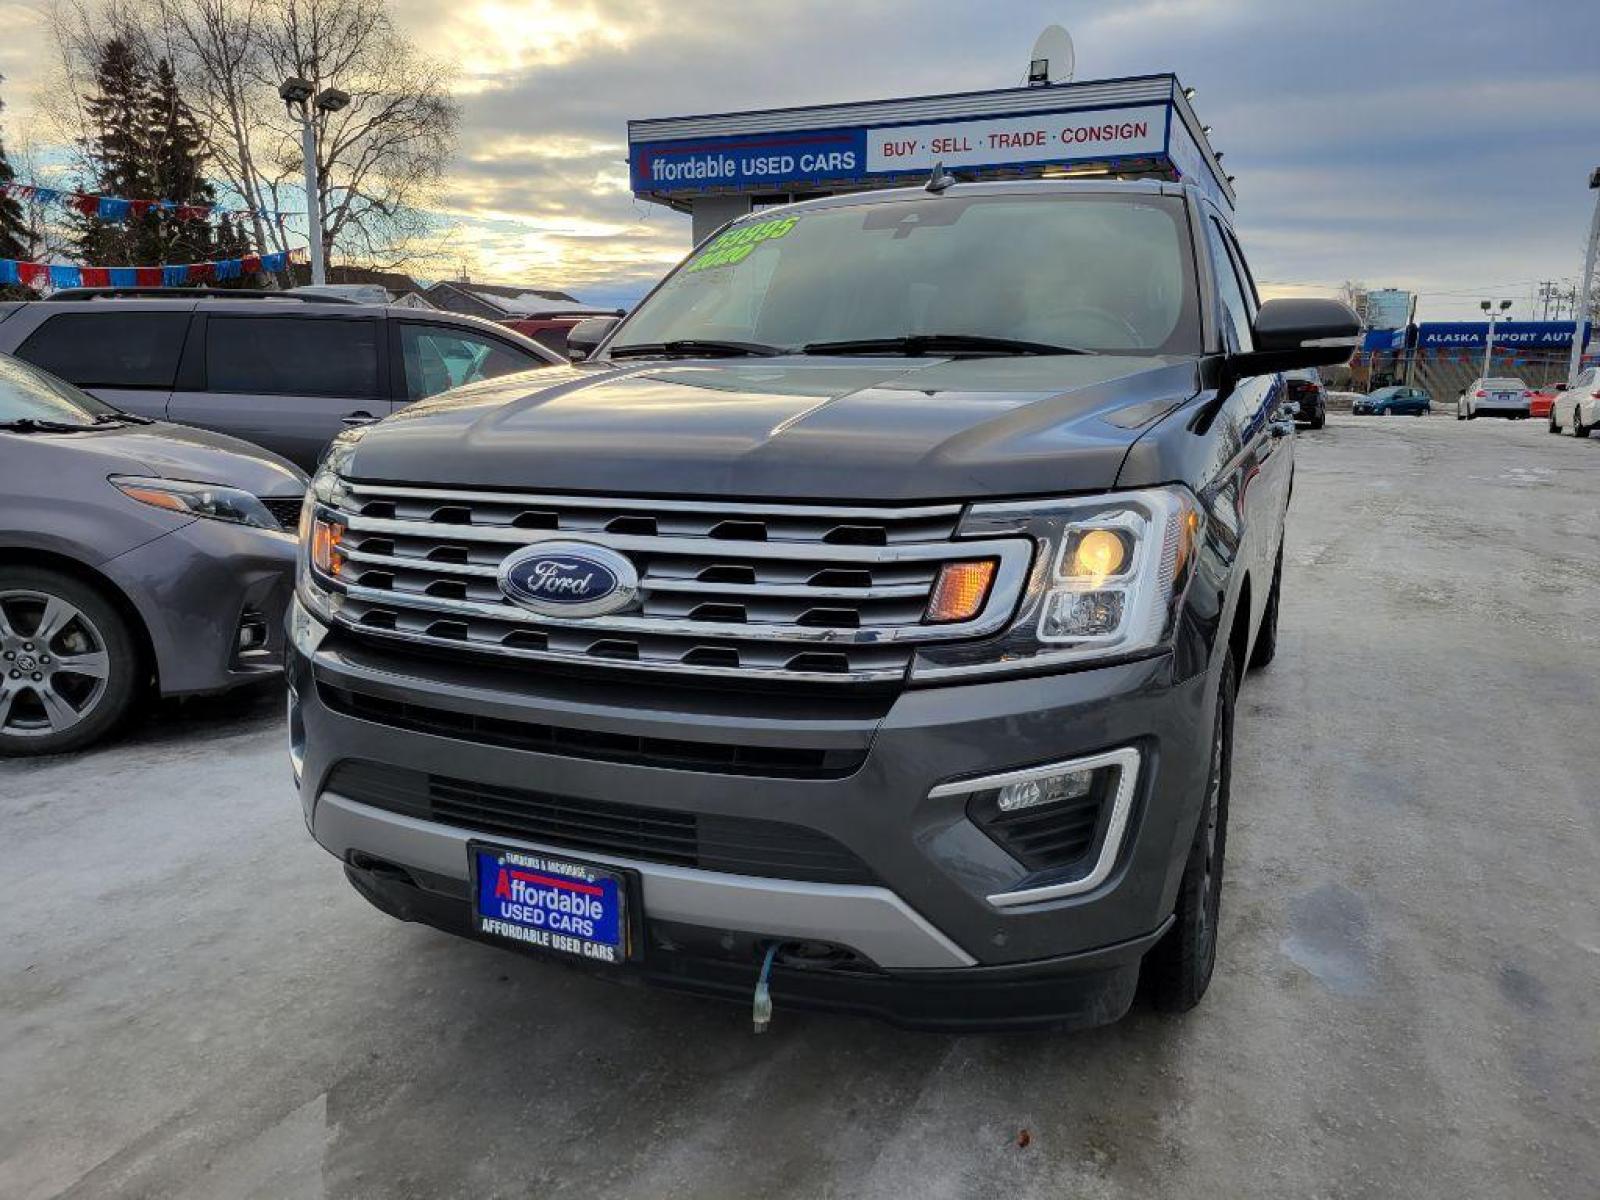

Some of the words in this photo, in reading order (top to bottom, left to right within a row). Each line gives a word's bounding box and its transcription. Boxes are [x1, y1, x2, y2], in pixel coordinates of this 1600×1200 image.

[883, 140, 917, 157] BUY
[931, 137, 972, 154] SELL
[988, 131, 1047, 149] TRADE
[1061, 122, 1148, 144] CONSIGN
[741, 155, 795, 176] USED
[800, 151, 856, 173] CARS
[1426, 333, 1479, 342] ALASKA
[1486, 332, 1537, 342] MPORT
[527, 560, 594, 595] Ford
[494, 868, 604, 920] Affordable
[501, 901, 545, 925] USED
[549, 912, 594, 937] CARS
[482, 918, 550, 947] AFFORDABLE
[552, 933, 582, 954] USED
[583, 941, 614, 962] CARS
